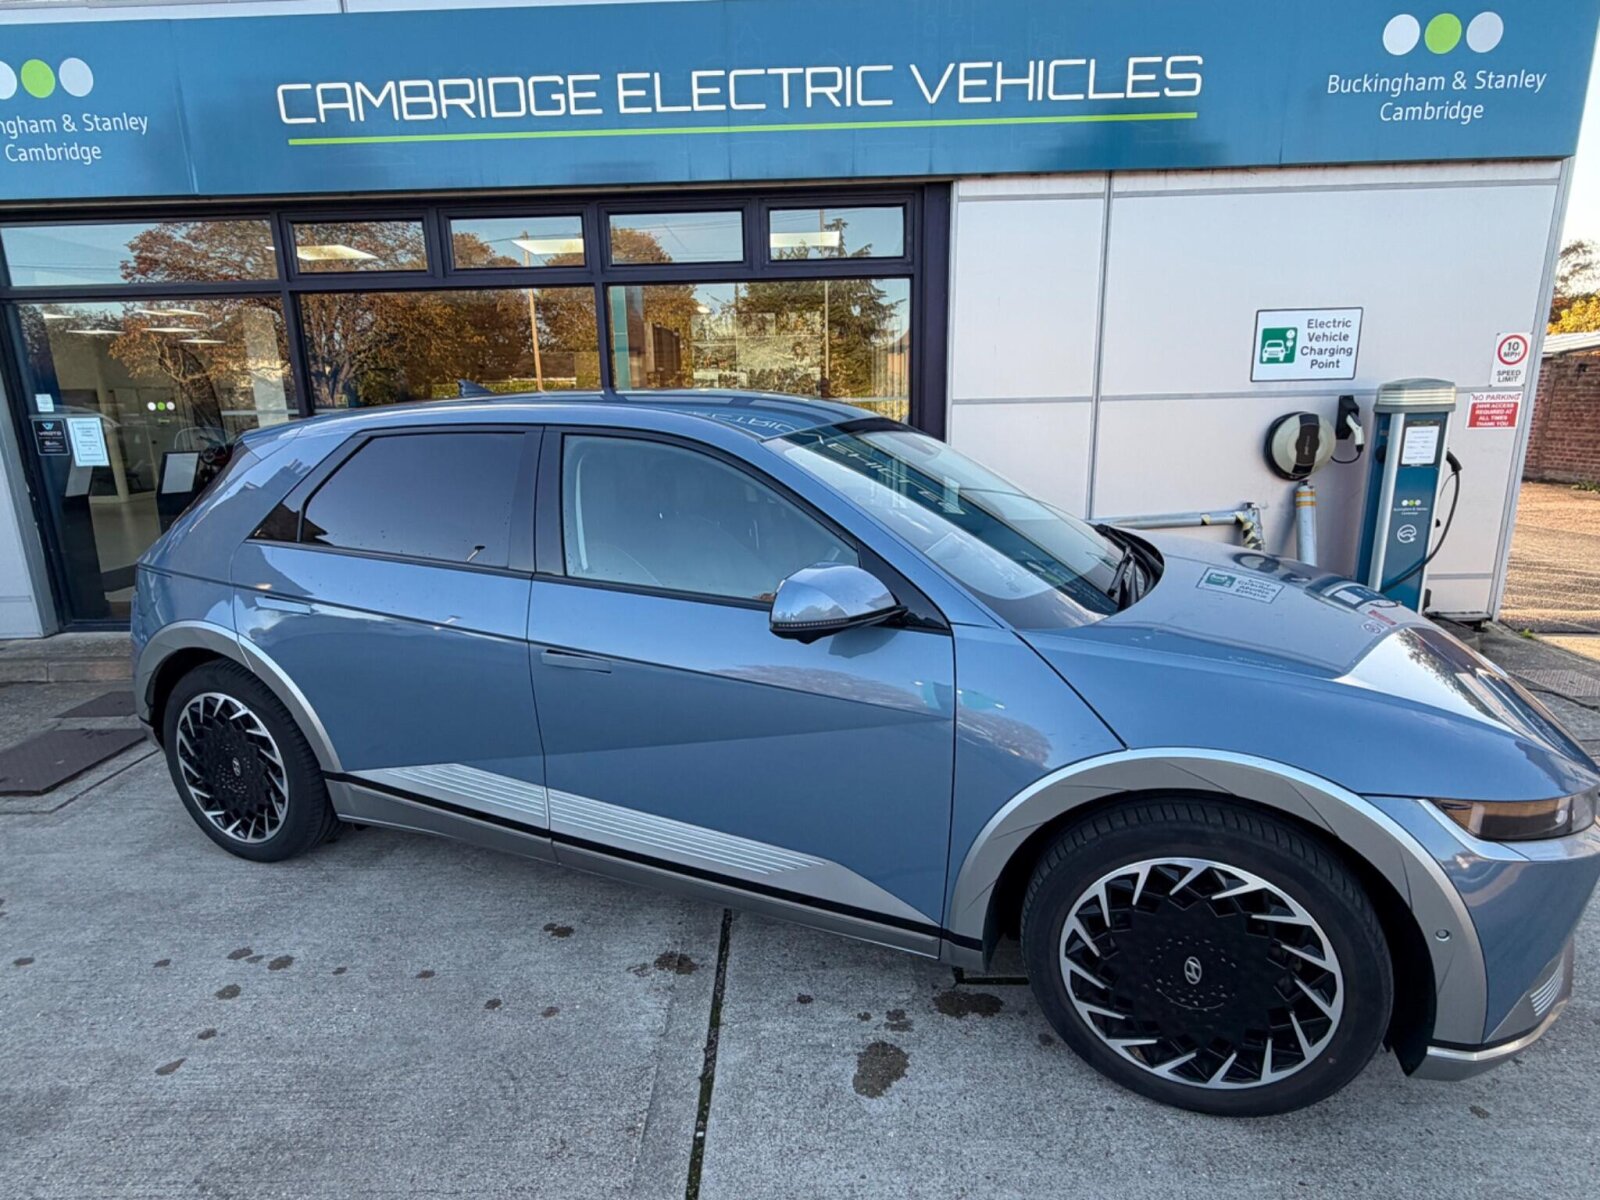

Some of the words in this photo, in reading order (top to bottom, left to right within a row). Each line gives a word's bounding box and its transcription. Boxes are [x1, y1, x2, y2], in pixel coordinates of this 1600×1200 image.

[276, 73, 603, 125] CAMBRIDGE
[617, 66, 893, 113] ELECTRIC
[909, 54, 1204, 105] VEHICLES
[1327, 73, 1446, 98] Buckingham
[1451, 70, 1467, 90] &
[1473, 69, 1548, 93] Stanley
[1379, 100, 1485, 125] Cambridge
[62, 113, 77, 133] &
[82, 112, 148, 135] Stanley
[5, 142, 103, 165] Cambridge
[1307, 318, 1352, 329] Electric
[1307, 332, 1350, 342] Vehicle
[1300, 345, 1353, 357] Charging
[1507, 341, 1520, 351] 10
[1310, 358, 1341, 369] Point
